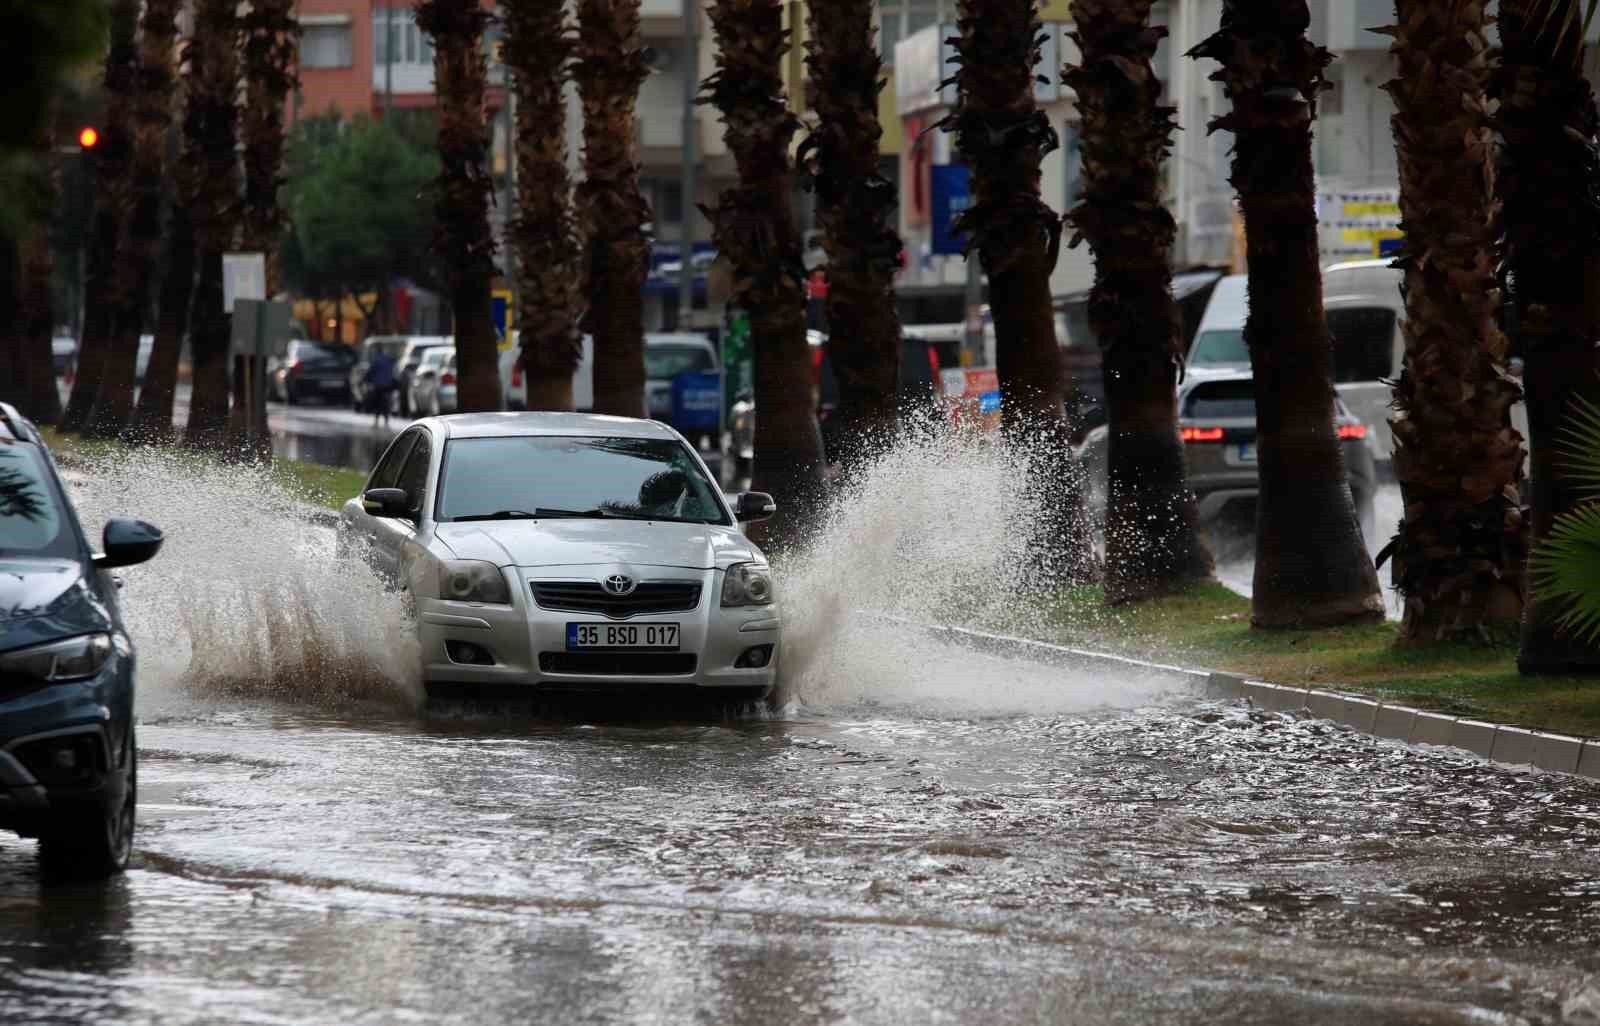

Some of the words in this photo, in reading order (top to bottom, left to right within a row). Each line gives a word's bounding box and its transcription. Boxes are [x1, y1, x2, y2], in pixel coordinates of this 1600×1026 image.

[578, 626, 598, 645] 35
[607, 626, 638, 645] BSD
[646, 626, 677, 645] 017
